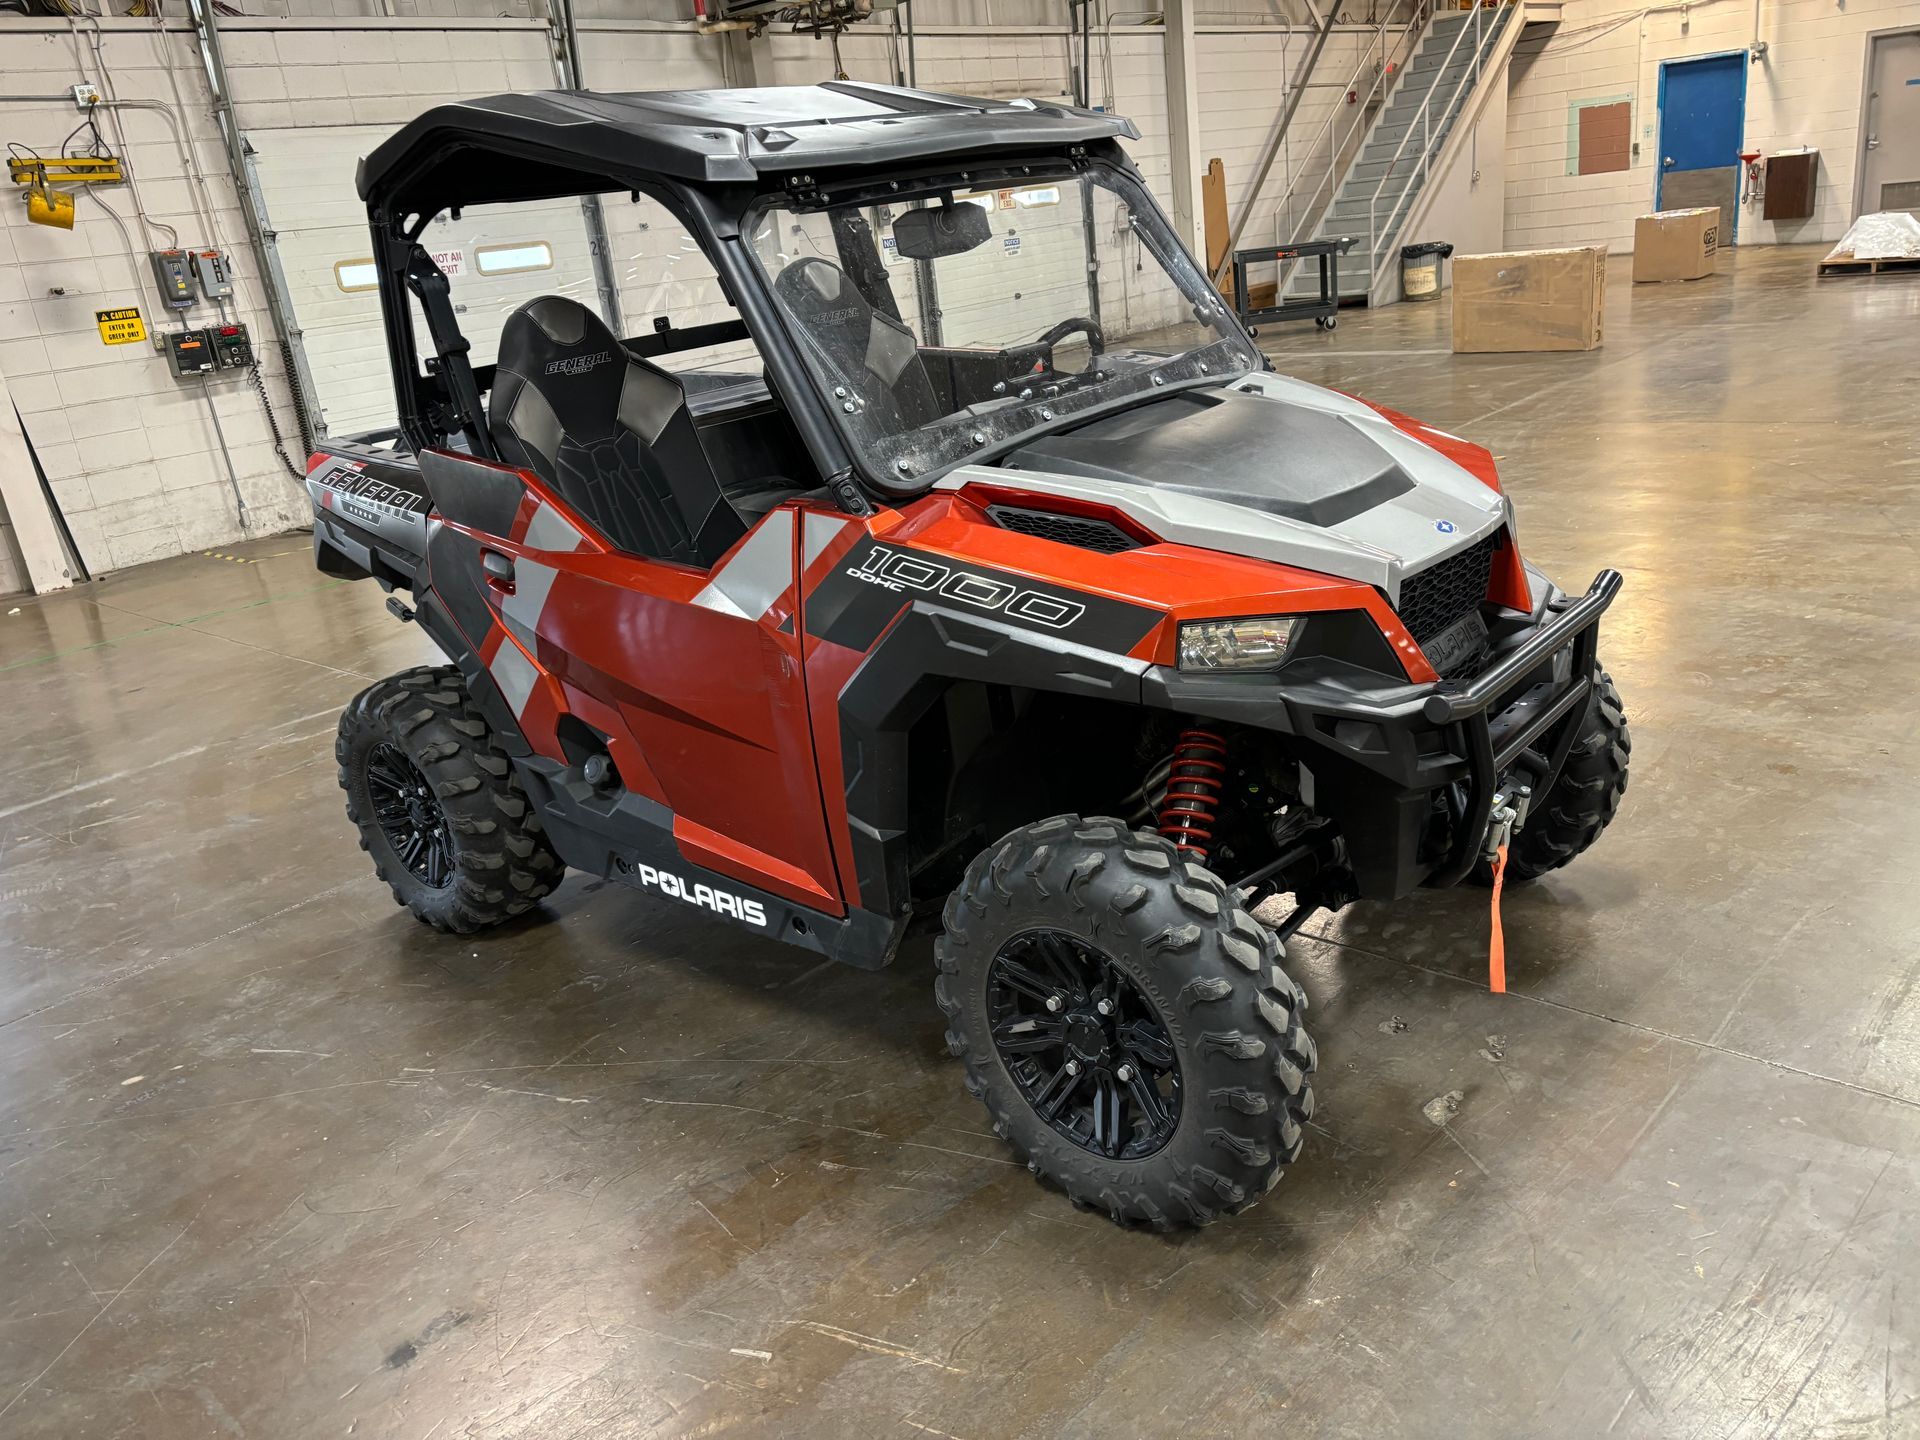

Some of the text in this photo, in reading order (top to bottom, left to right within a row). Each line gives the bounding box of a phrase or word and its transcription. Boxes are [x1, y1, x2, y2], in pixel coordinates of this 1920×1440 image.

[432, 251, 463, 264] NOT AN
[590, 241, 599, 256] 2
[441, 264, 458, 275] EXIT
[110, 310, 138, 320] CAUTION
[811, 307, 859, 325] GENERAL
[108, 323, 125, 331] ENTER
[545, 351, 612, 375] GENERAL
[319, 465, 423, 525] GENERAL
[846, 568, 905, 592] DOHC
[861, 546, 1086, 629] 1000
[1426, 621, 1481, 666] OLARIS
[638, 863, 767, 926] POLARIS
